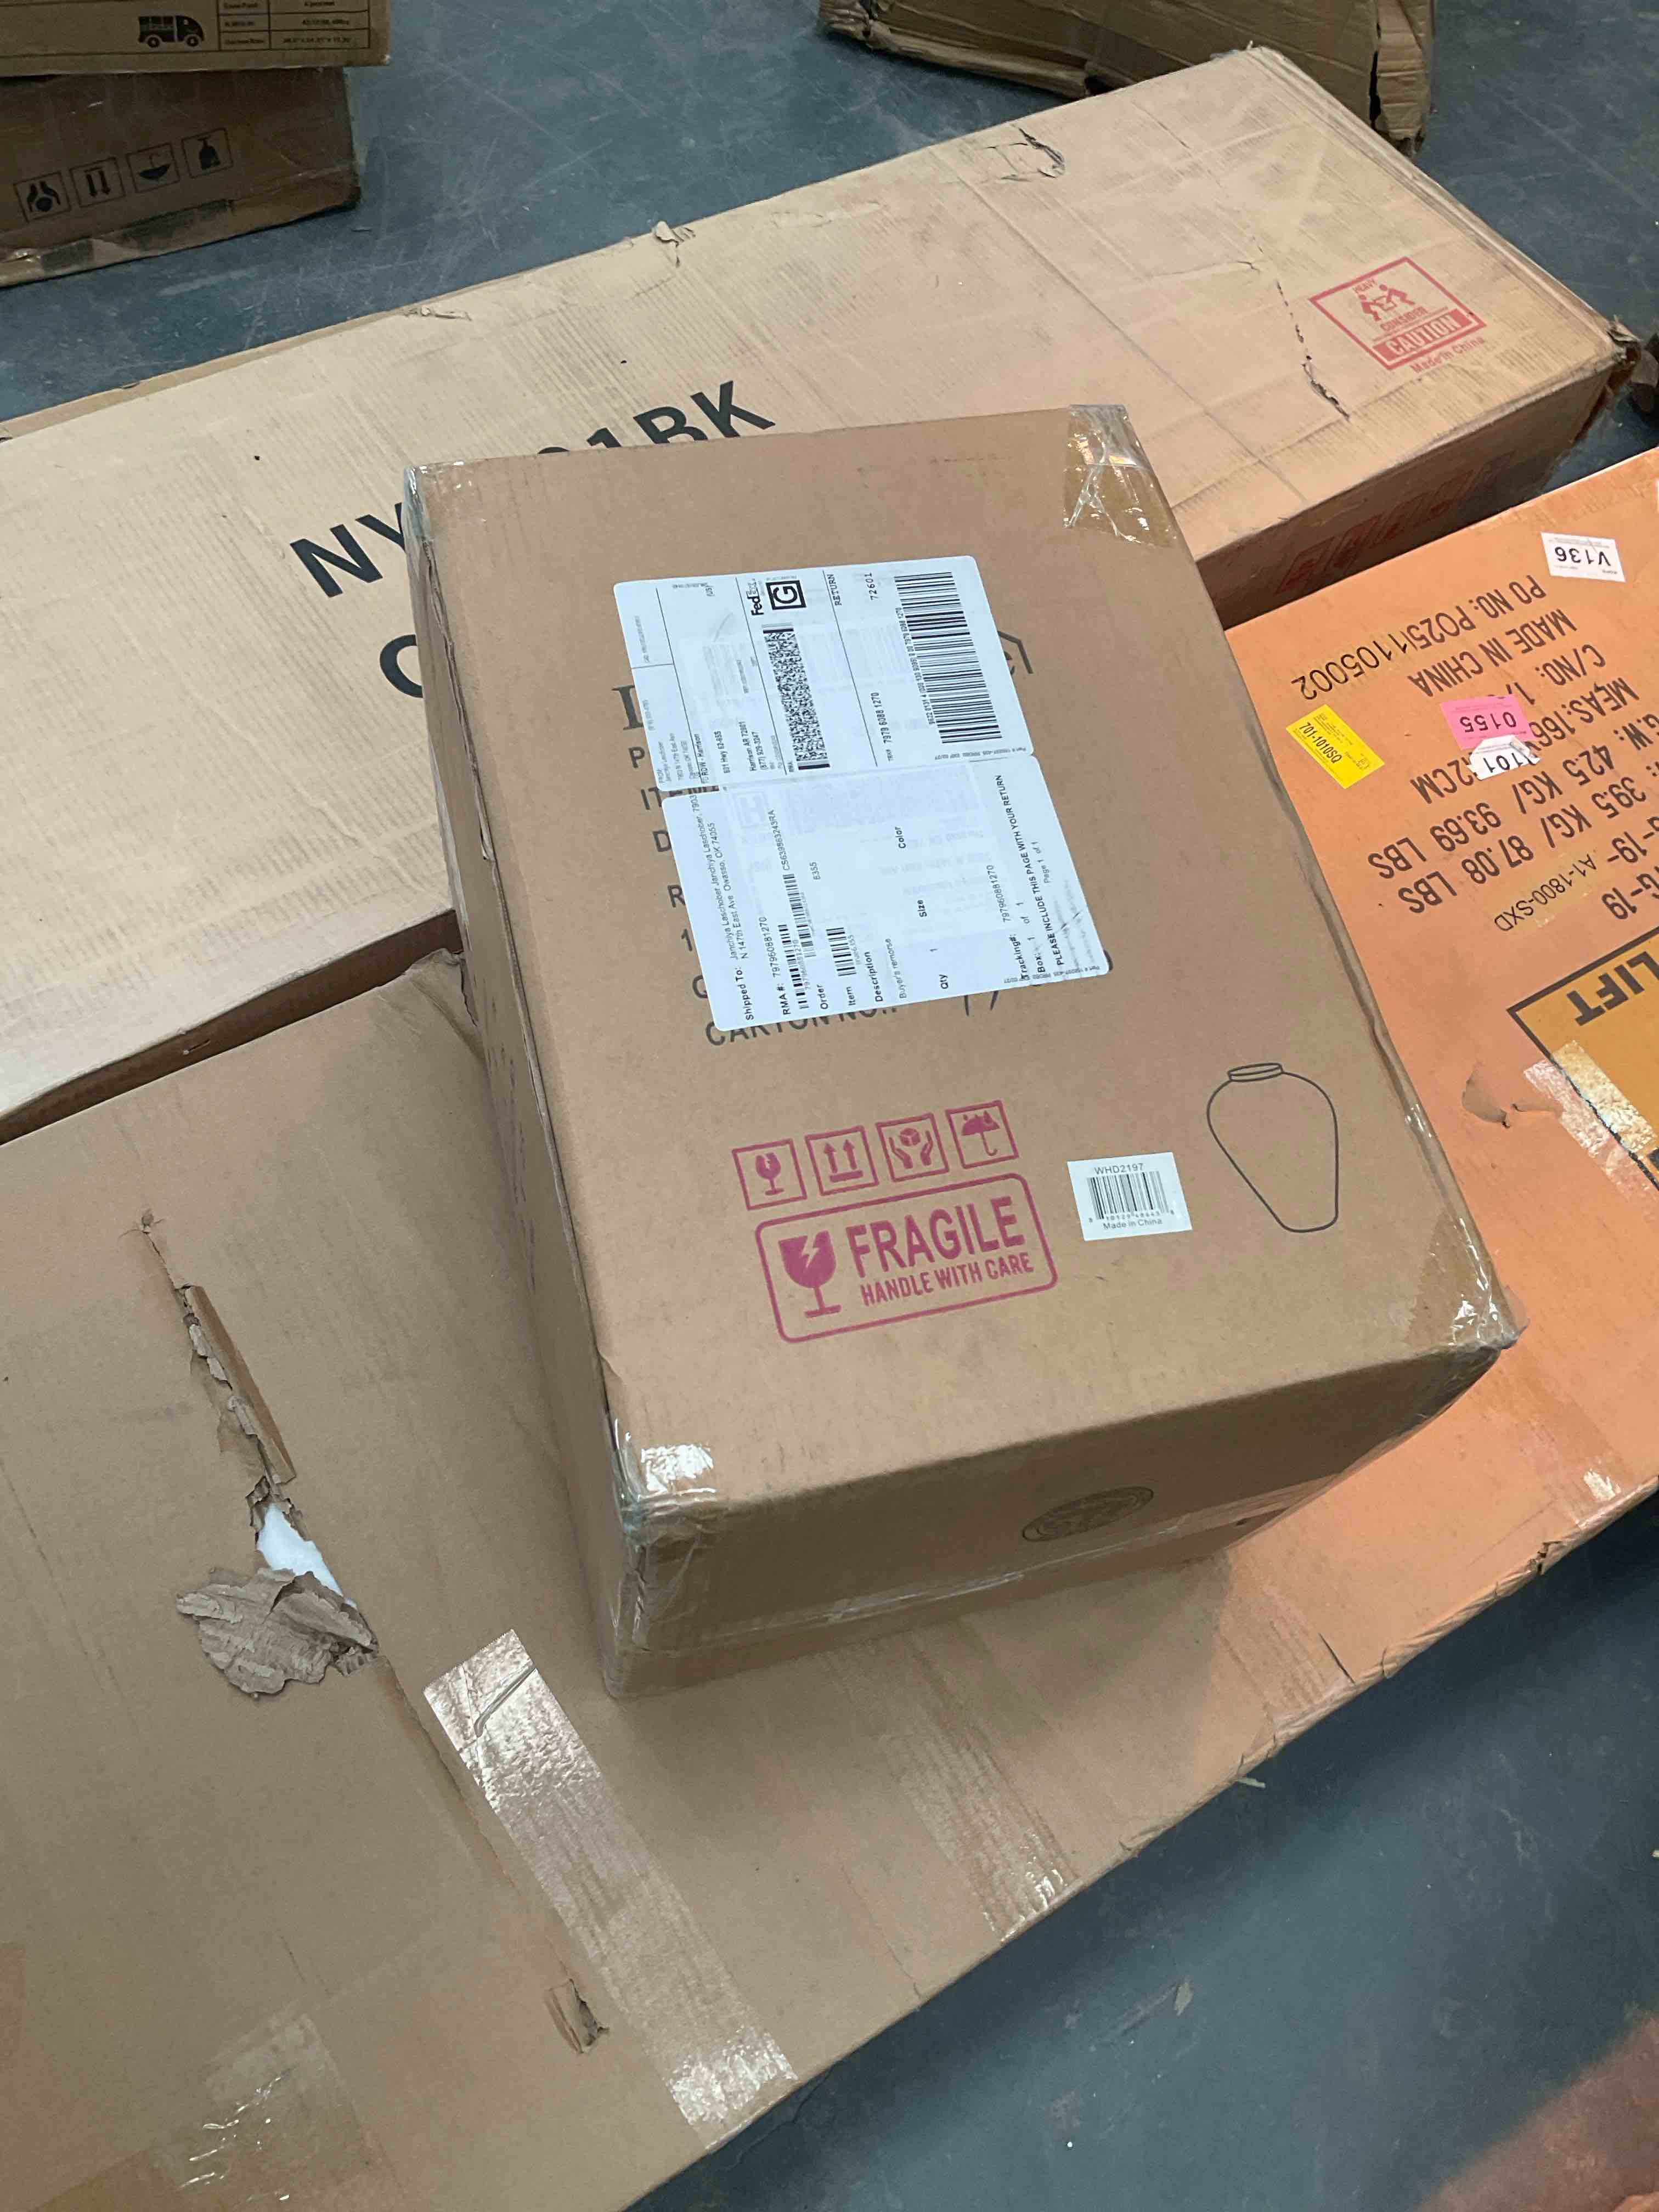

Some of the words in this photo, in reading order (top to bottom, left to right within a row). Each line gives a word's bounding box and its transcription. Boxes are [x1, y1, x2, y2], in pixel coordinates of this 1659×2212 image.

[1380, 306, 1427, 331] CONSIDER
[1386, 314, 1463, 356] CAUTION
[1409, 356, 1440, 373] Made
[1441, 351, 1453, 361] in
[1452, 337, 1485, 356] China
[1555, 546, 1611, 567] V136
[747, 579, 765, 616] FedEx
[771, 585, 799, 604] G
[827, 574, 842, 606] RETURN
[865, 573, 878, 600] 72601
[1509, 574, 1547, 605] PO
[1469, 588, 1514, 619] NO:
[1505, 608, 1577, 654] MADE
[1479, 637, 1514, 667] IN
[1534, 644, 1606, 686] C/NO:
[1407, 651, 1483, 697] CHINA
[871, 692, 882, 708] 1270
[876, 710, 887, 725] 6088
[1460, 711, 1517, 734] 0155
[881, 727, 891, 743] 7979
[1298, 721, 1343, 765] 701-1010SQ
[747, 748, 757, 771] Harrison
[1562, 744, 1615, 786] 42.5
[689, 795, 699, 812] 7903
[995, 776, 1011, 805] RETURN
[1512, 771, 1563, 814] KG/
[1591, 776, 1646, 819] 39.5
[707, 823, 720, 844] 74055
[1006, 808, 1018, 830] YOUR
[1430, 802, 1502, 851] 93.69
[1541, 804, 1592, 849] KG/
[713, 847, 724, 858] OK
[895, 827, 906, 848] Color
[1014, 831, 1025, 851] WITH
[707, 854, 719, 885] Janchiya
[809, 862, 821, 879] 6355
[1020, 853, 1034, 874] PAGE
[1368, 837, 1427, 879] LBS
[1461, 835, 1534, 884] 87.08
[1029, 877, 1040, 894] THIS
[1041, 865, 1051, 883] Page
[714, 888, 729, 926] Laschober
[728, 895, 736, 909] Ave
[986, 865, 1011, 922] 797960881270
[1398, 871, 1458, 913] LBS
[1601, 866, 1659, 921] G-19
[731, 911, 741, 928] East
[917, 900, 927, 917] Size
[1035, 896, 1053, 931] INCLUDE
[725, 928, 738, 960] Janchiya
[736, 930, 746, 950] 147th
[759, 917, 781, 978] 797960881270
[885, 939, 898, 969] remorse
[1047, 933, 1064, 965] PLEASE
[1009, 934, 1029, 979] Tracking#:
[1035, 953, 1045, 972] Box:
[735, 968, 743, 981] To:
[865, 952, 883, 1002] Description
[893, 971, 907, 998] Buyer's
[939, 974, 948, 989] Qty
[1566, 951, 1659, 1026] LIFT
[737, 984, 754, 1020] Shipped
[779, 994, 791, 1015] RMA
[817, 985, 828, 1009] Order
[847, 987, 856, 1006] Item
[1094, 1163, 1144, 1175] WHD2197
[846, 1196, 1025, 1278] FRAGILE
[1138, 1218, 1163, 1226] China
[860, 1271, 934, 1307] HANDLE
[934, 1261, 982, 1290] WITH
[988, 1252, 1035, 1280] CARE
